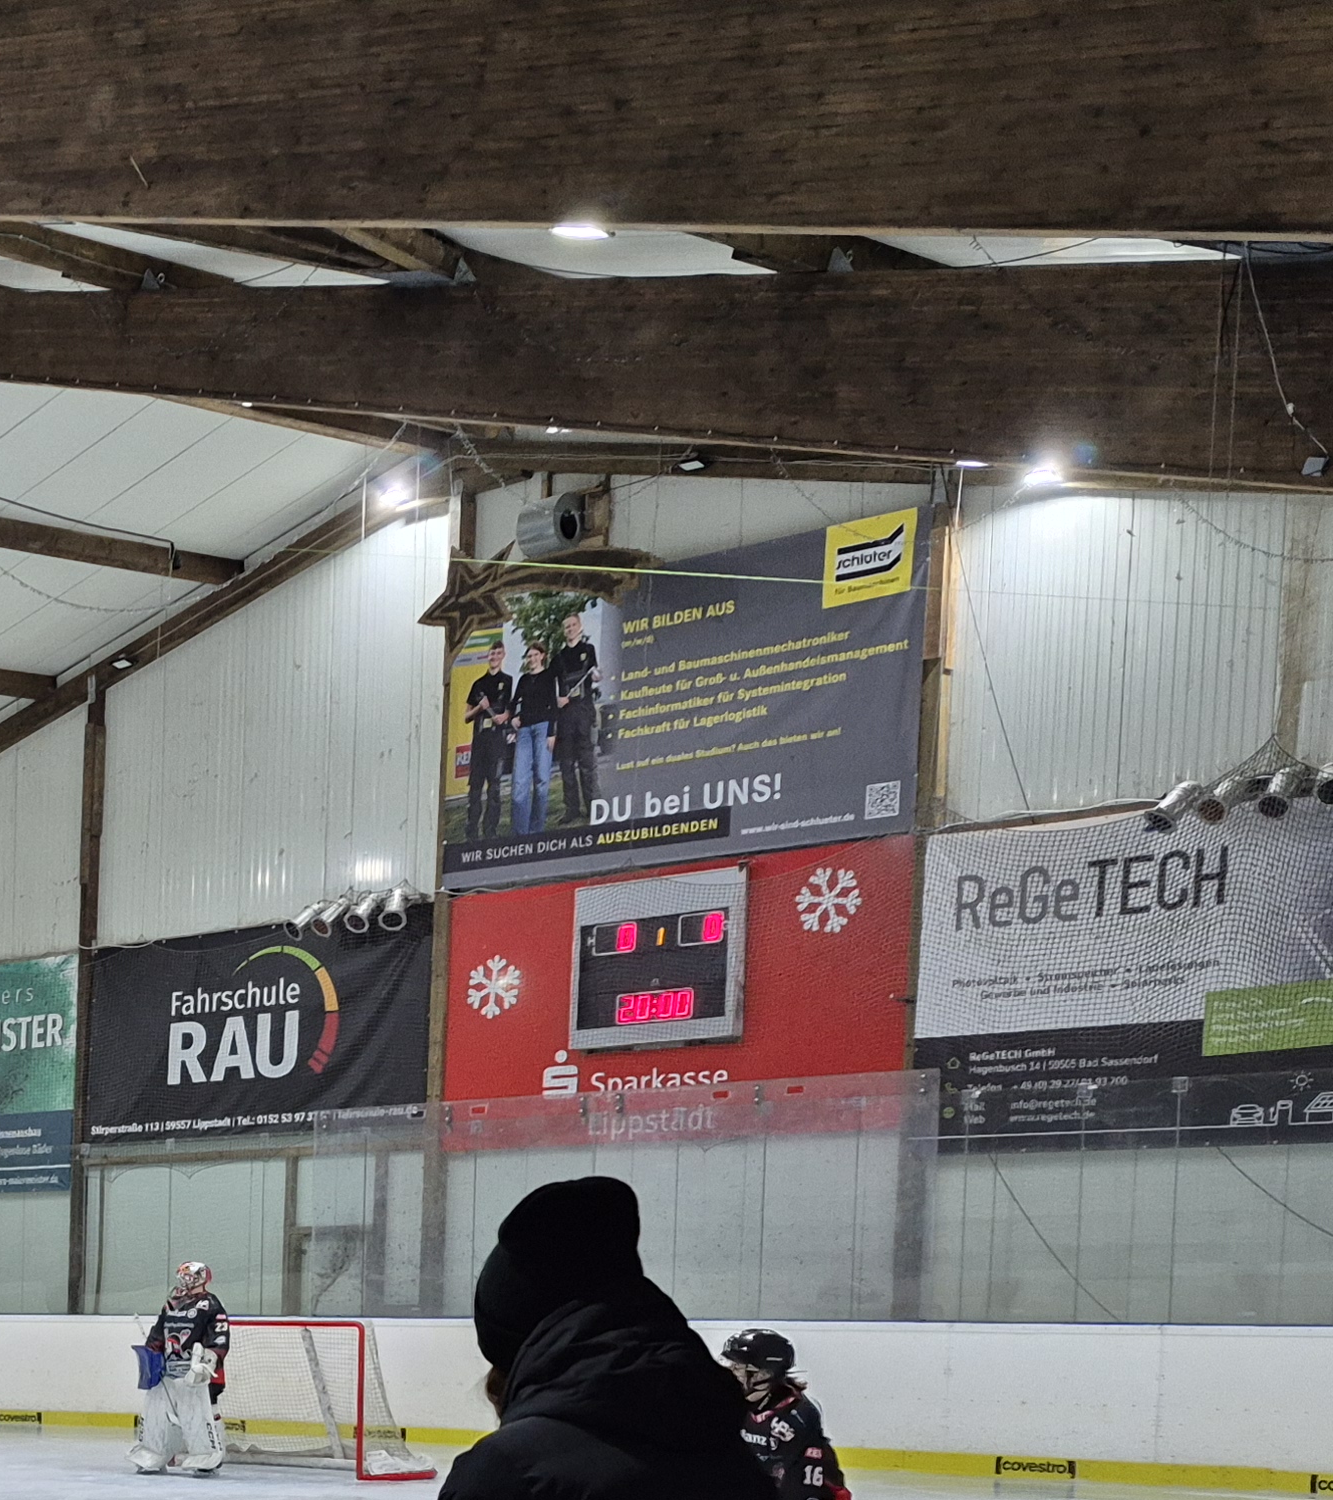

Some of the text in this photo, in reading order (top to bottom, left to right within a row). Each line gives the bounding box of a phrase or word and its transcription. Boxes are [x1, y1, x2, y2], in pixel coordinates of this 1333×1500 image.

[623, 600, 736, 634] WIR BILDEN AUS
[621, 634, 655, 649] (m/w/d)
[621, 630, 851, 682] Land- und Baumaschinenmechatroniker
[620, 639, 909, 701] Kaufleute für Groß- u. Außenhandelsmanagement
[619, 672, 847, 720] Fachinformatiker für Systemintegration
[618, 704, 768, 739] Fachkraft für Lagerlogistik
[616, 757, 634, 770] Lust
[738, 740, 759, 752] Auch
[761, 738, 777, 748] das
[780, 732, 808, 745] bieten
[810, 730, 824, 740] wir
[590, 772, 782, 826] DU bei UNS!
[461, 817, 719, 864] WIR SUCHEN DICH ALS AUSZUBILDENDEN
[955, 846, 1228, 931] ReGeTECH
[616, 922, 638, 952] 0
[655, 927, 666, 947] 1
[702, 911, 724, 943] 0
[171, 976, 301, 1017] Fahrschule
[618, 990, 693, 1023] 20:00
[166, 1009, 300, 1085] RAU
[969, 1047, 1056, 1062] ReGeTECH GmbH
[969, 1062, 1027, 1076] Hagenbusch
[1079, 1056, 1098, 1068] Bad
[1101, 1053, 1159, 1067] Sassendorf
[591, 1067, 728, 1098] Sparkasse
[145, 1122, 159, 1133] 113
[164, 1119, 191, 1131] 59557
[192, 1116, 231, 1132] Lippstadt
[237, 1115, 255, 1126] Tel.:
[256, 1112, 279, 1125] 0152
[280, 1112, 292, 1123] 53
[294, 1111, 305, 1123] 97
[588, 1103, 717, 1141] Lippstadt
[214, 1321, 228, 1333] 23
[803, 1465, 824, 1487] 16
[1002, 1458, 1067, 1474] covestro
